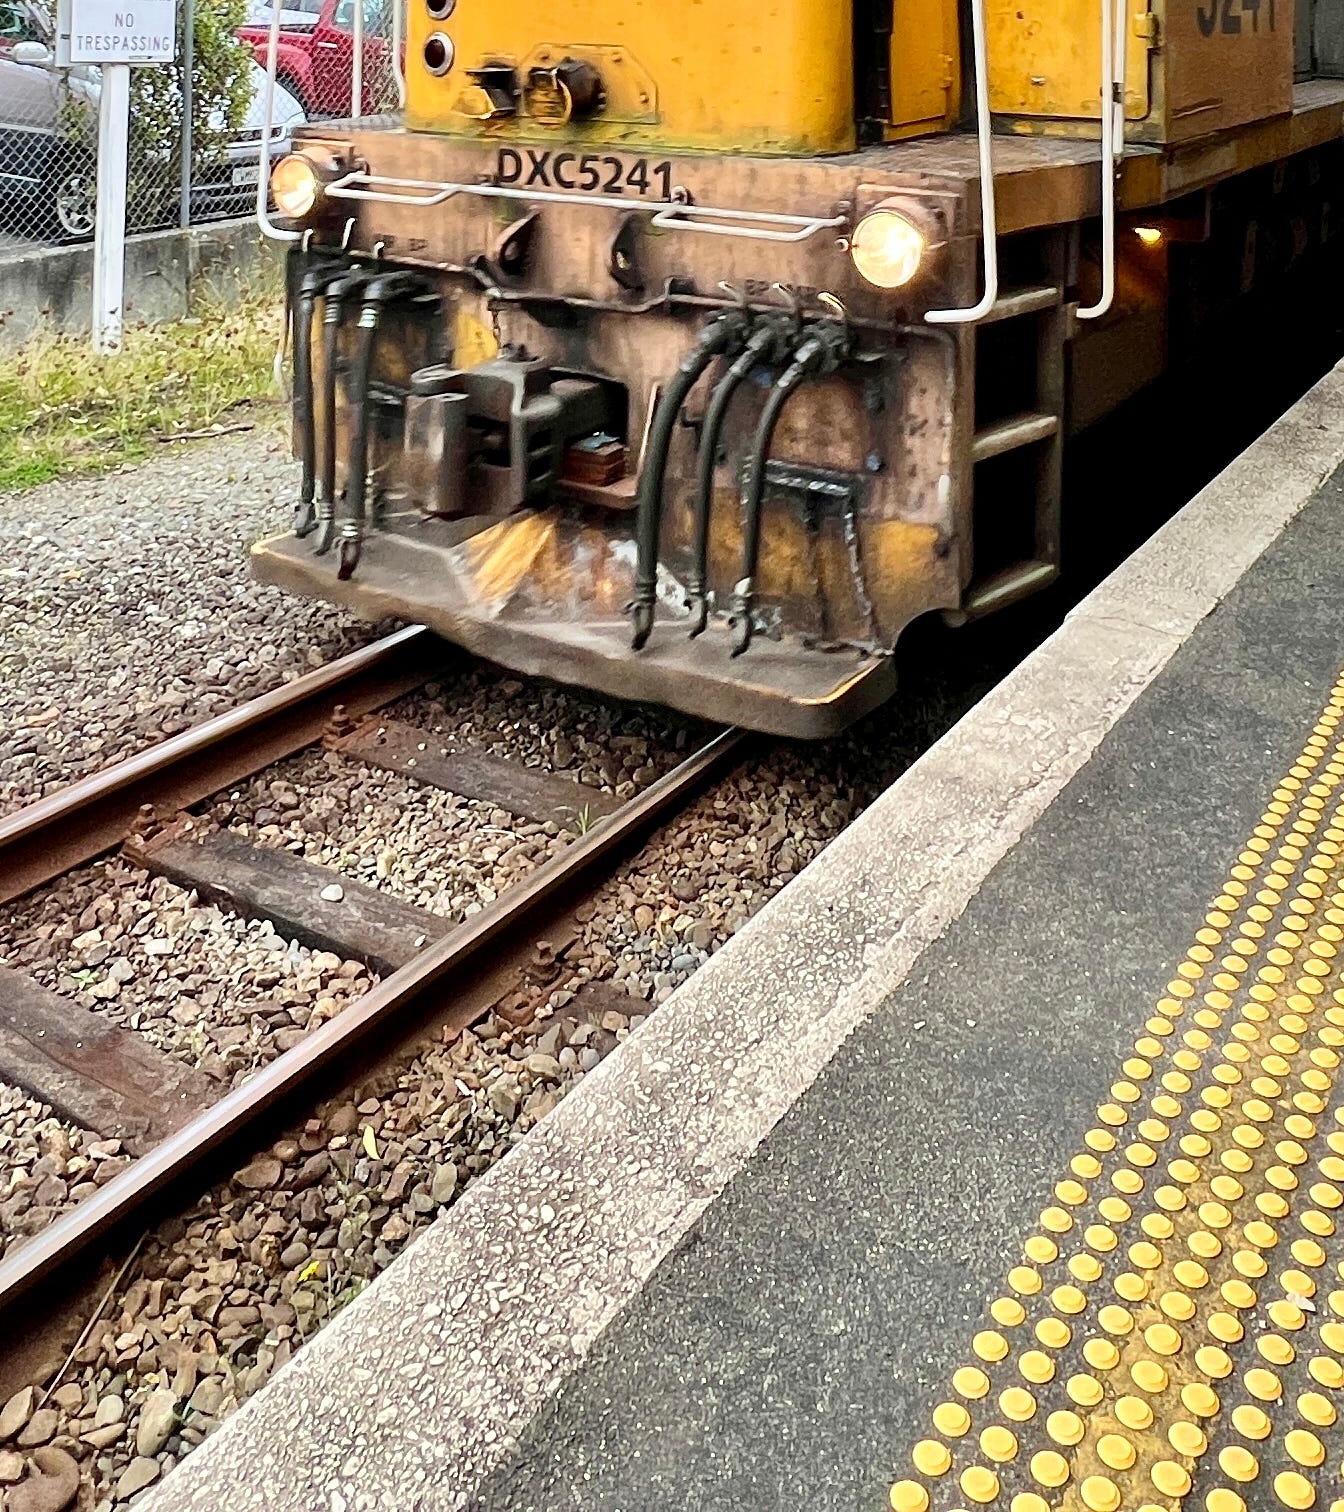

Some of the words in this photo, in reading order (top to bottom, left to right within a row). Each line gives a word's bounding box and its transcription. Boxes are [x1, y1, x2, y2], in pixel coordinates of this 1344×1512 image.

[114, 12, 135, 28] NO
[76, 35, 171, 52] TRESPASSING
[497, 147, 673, 199] DXC5241
